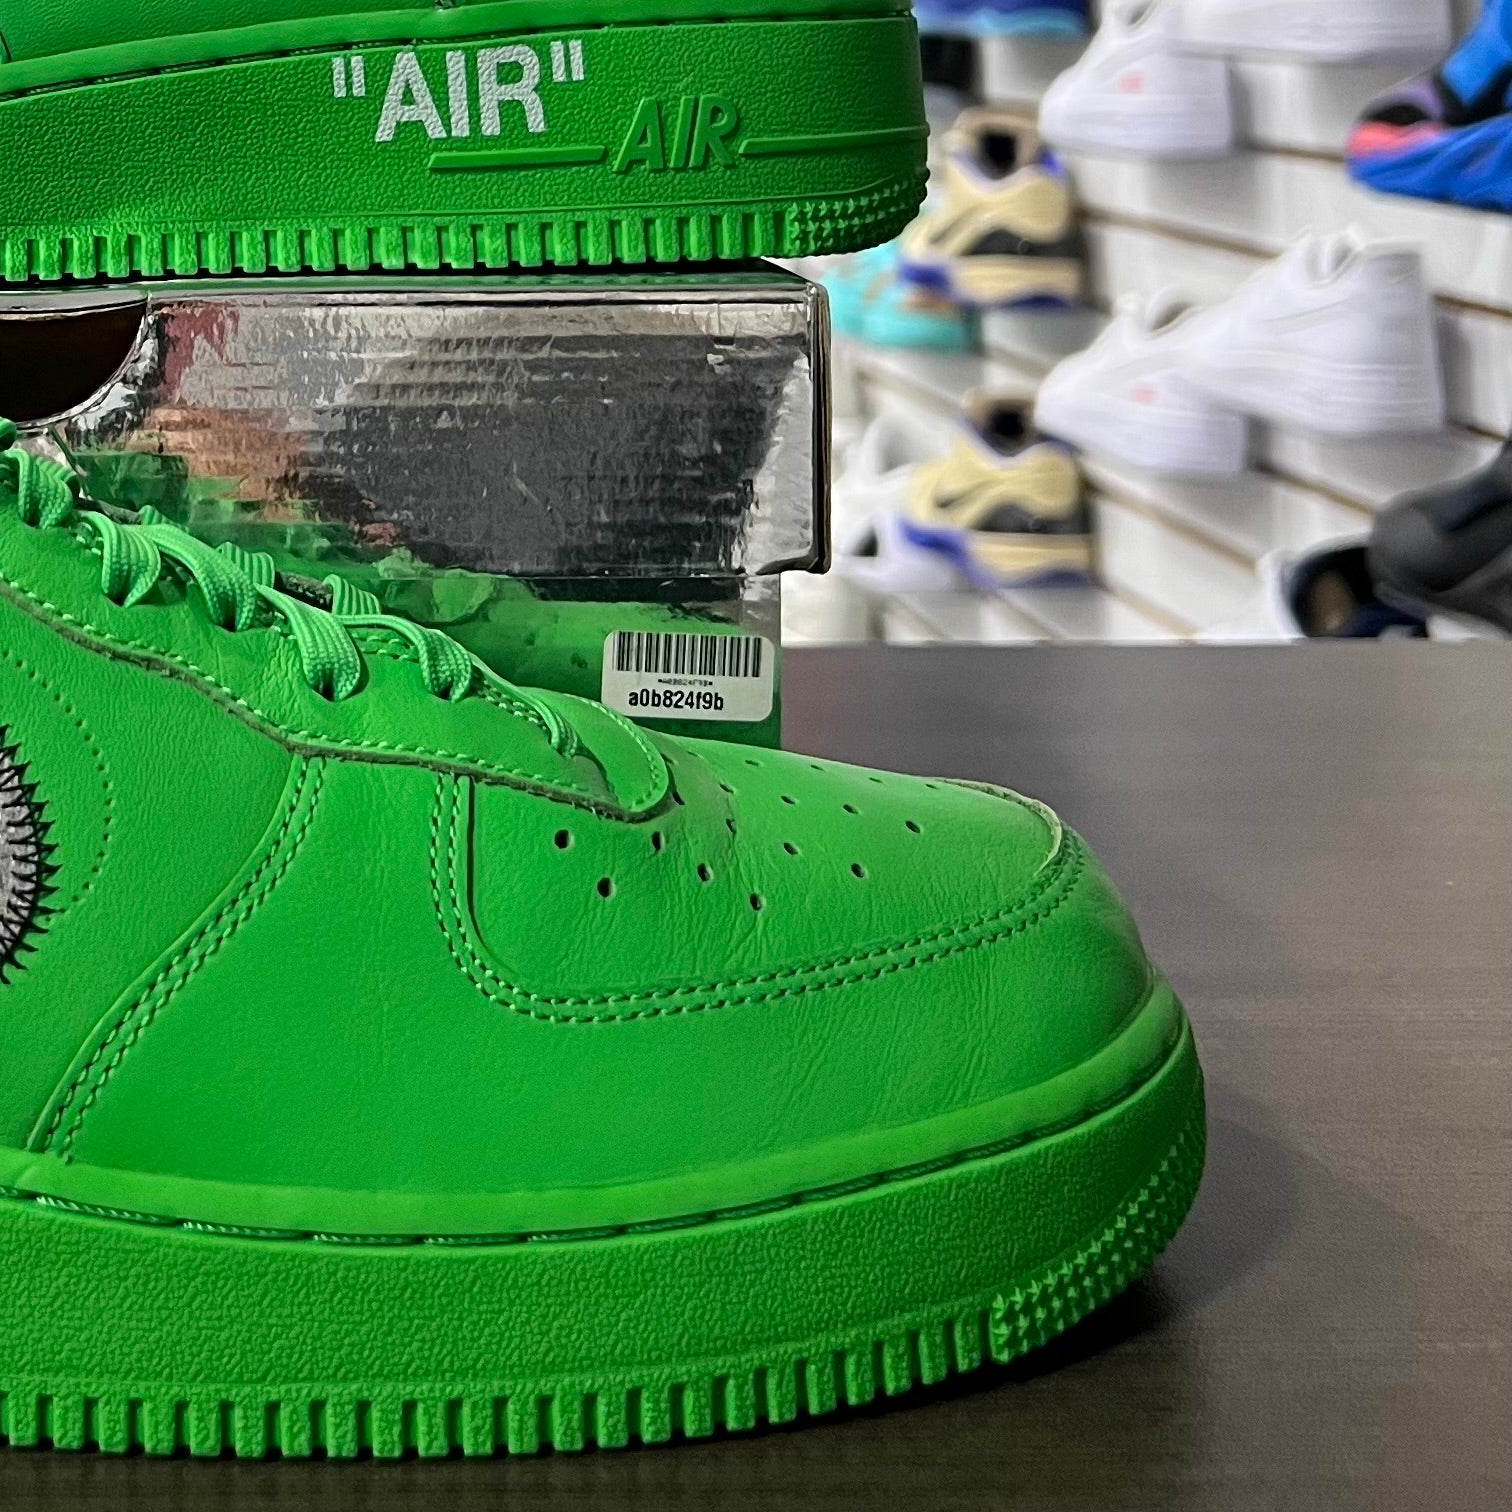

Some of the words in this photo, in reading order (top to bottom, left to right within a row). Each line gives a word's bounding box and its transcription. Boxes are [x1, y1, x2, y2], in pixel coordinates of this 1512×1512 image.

[331, 40, 585, 143] "AIR"
[613, 96, 738, 173] AIR
[628, 688, 724, 710] a0b824f9b
